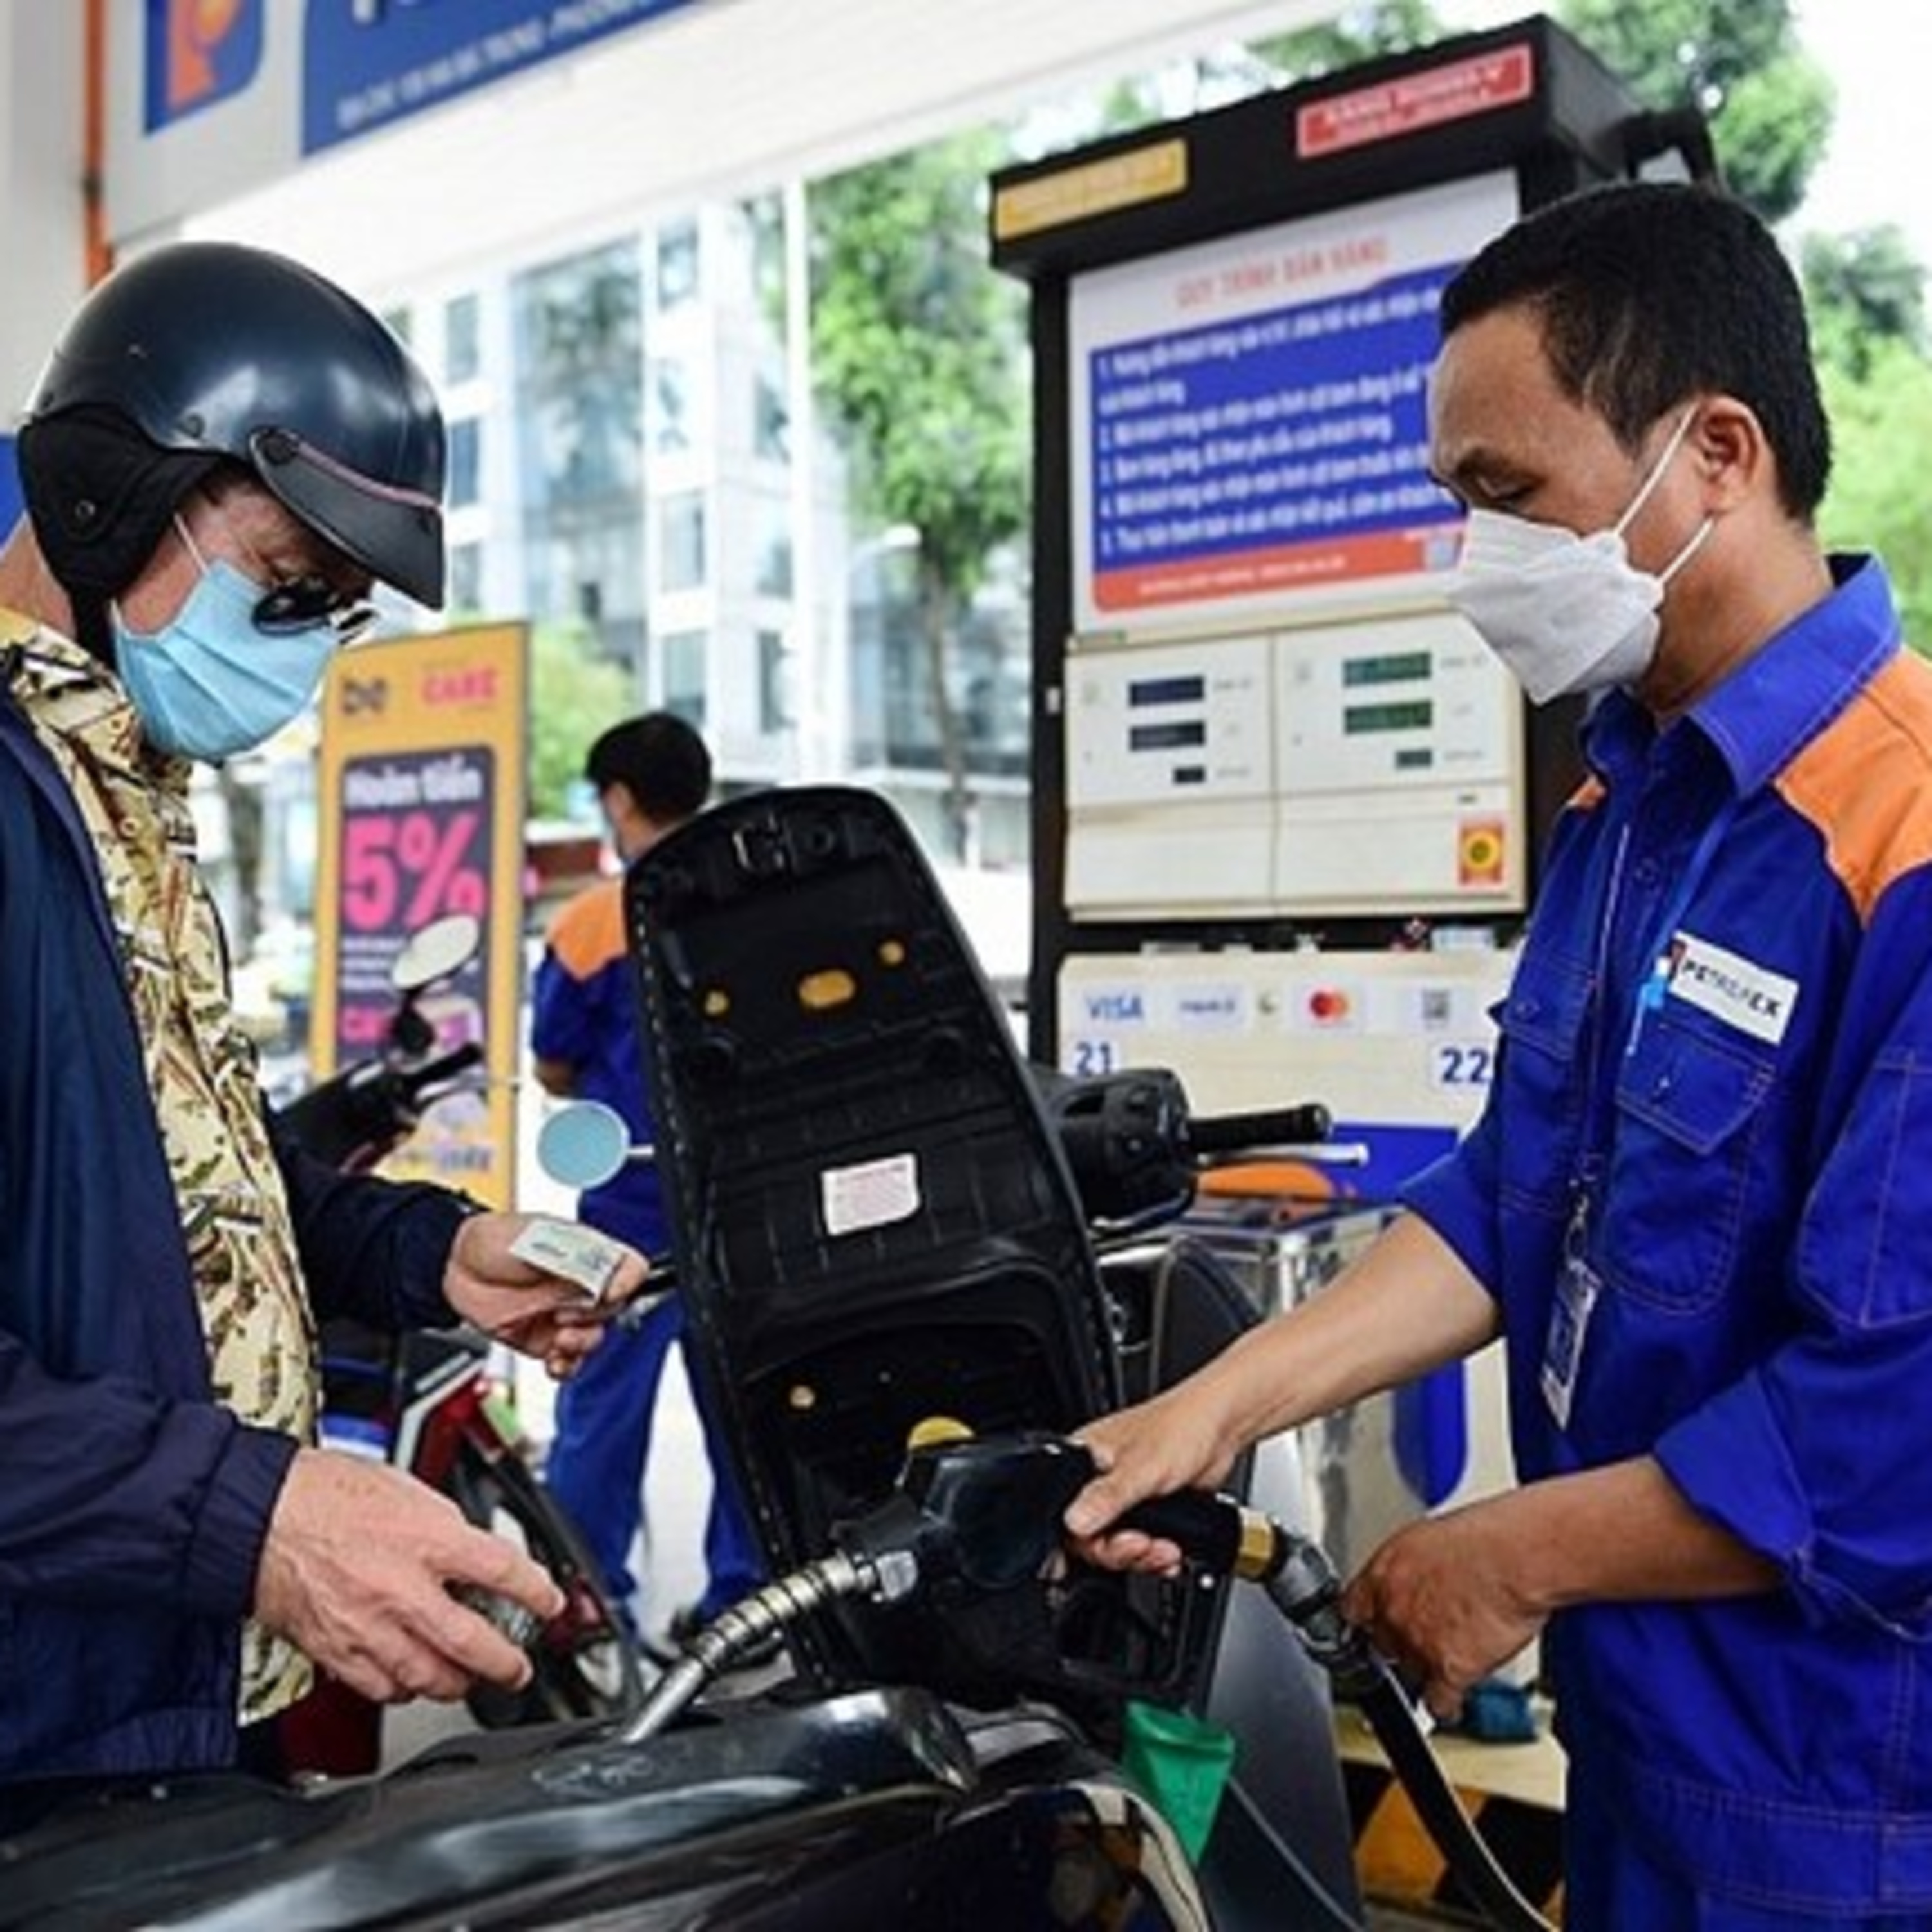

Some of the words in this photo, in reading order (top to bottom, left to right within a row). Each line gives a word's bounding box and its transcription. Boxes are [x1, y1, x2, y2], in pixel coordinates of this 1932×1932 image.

[343, 813, 486, 930] 5%
[1084, 995, 1144, 1020] VISA
[1075, 1041, 1112, 1077] 21
[1441, 1048, 1491, 1083] 22
